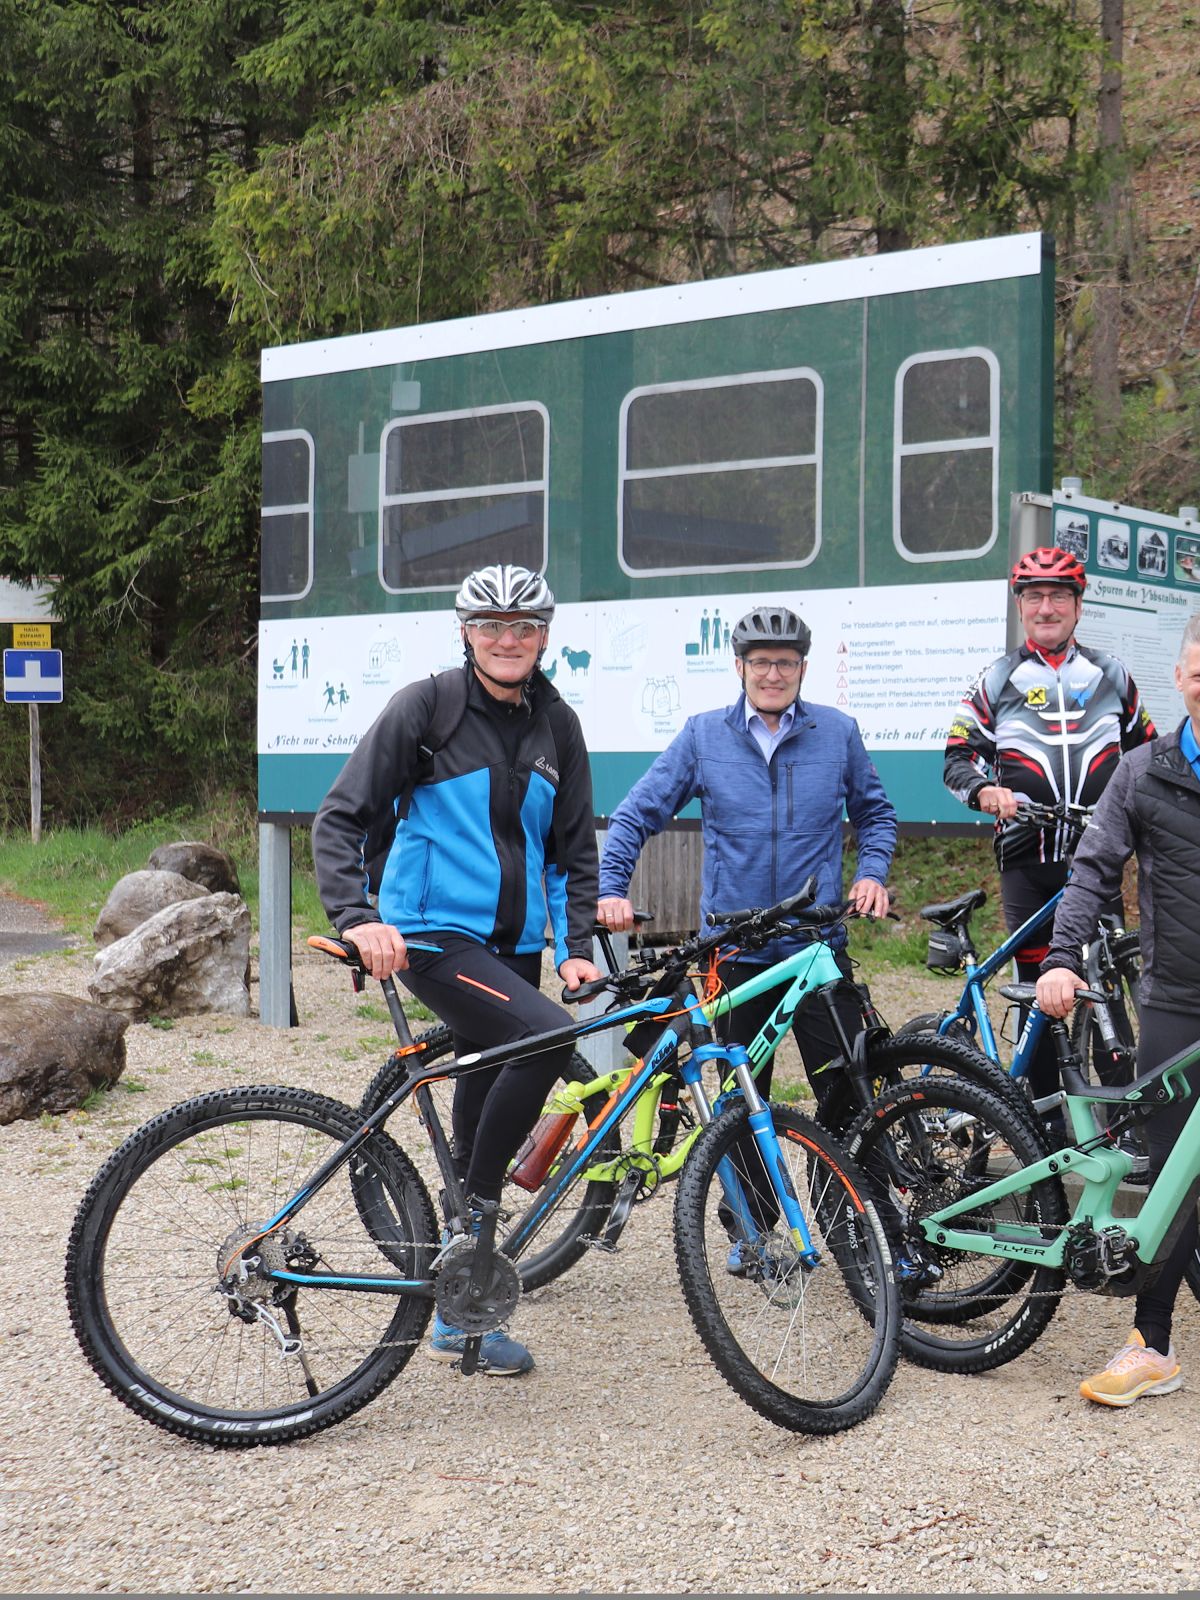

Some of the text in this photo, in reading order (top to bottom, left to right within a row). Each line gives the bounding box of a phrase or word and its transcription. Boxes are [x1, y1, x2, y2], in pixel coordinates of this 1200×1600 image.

[1094, 580, 1123, 598] Spuren
[1126, 586, 1138, 598] der
[1141, 588, 1188, 606] Ybbstalbahn
[853, 621, 893, 630] Ybbstalbahn
[850, 639, 895, 648] Naturgewalten
[882, 675, 948, 685] Umstrukturierungen
[889, 689, 940, 698] Pferdekutschen
[267, 734, 299, 749] Nicht
[303, 736, 319, 745] nur
[875, 728, 900, 740] sich
[904, 728, 927, 741] auf
[650, 1040, 676, 1070] KTM
[847, 1222, 859, 1250] SWISS
[992, 1243, 1046, 1257] FLYER
[983, 1305, 1031, 1354] MAXXIS
